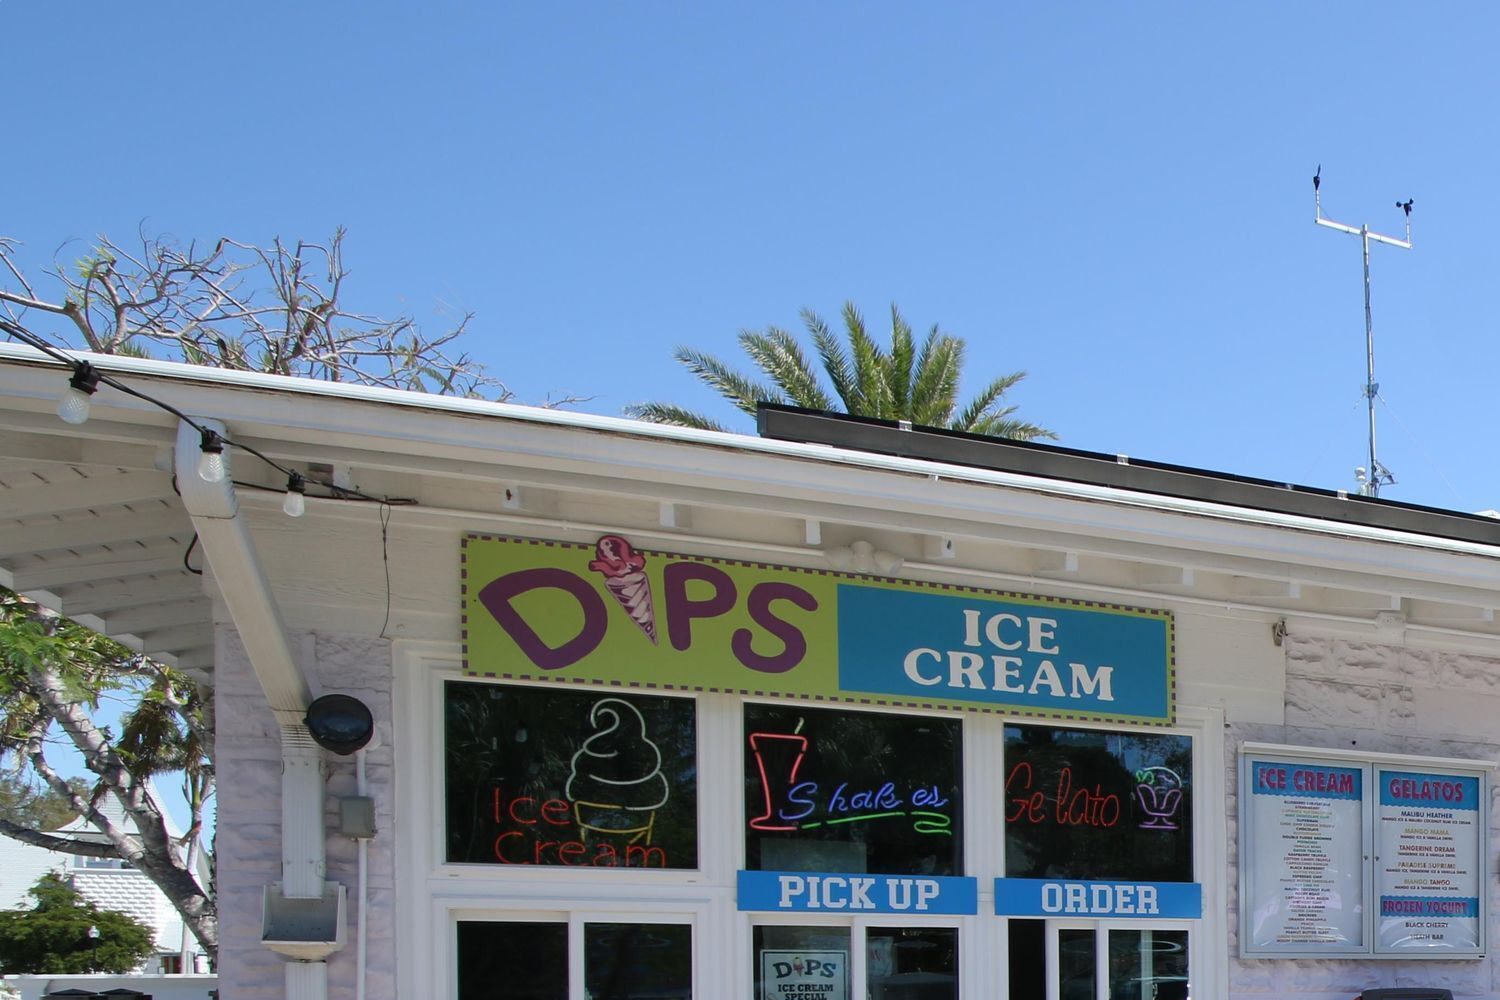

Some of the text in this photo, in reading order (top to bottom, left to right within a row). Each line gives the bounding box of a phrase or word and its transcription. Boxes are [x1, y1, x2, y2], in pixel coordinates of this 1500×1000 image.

[963, 610, 1059, 655] ICE
[904, 648, 1114, 701] CREAM
[1004, 762, 1120, 826] Gelato
[1258, 767, 1353, 793] ICE CREAM
[1390, 778, 1464, 802] GELATOS
[494, 787, 571, 825] Ice
[779, 782, 950, 820] Shakes
[495, 831, 667, 868] Cream
[779, 876, 940, 911] PICK UP
[1042, 883, 1160, 914] ORDER
[1383, 900, 1467, 913] FROZEN YOGURT
[777, 983, 834, 992] ICE CREAM
[785, 993, 827, 1000] SPECIAL
